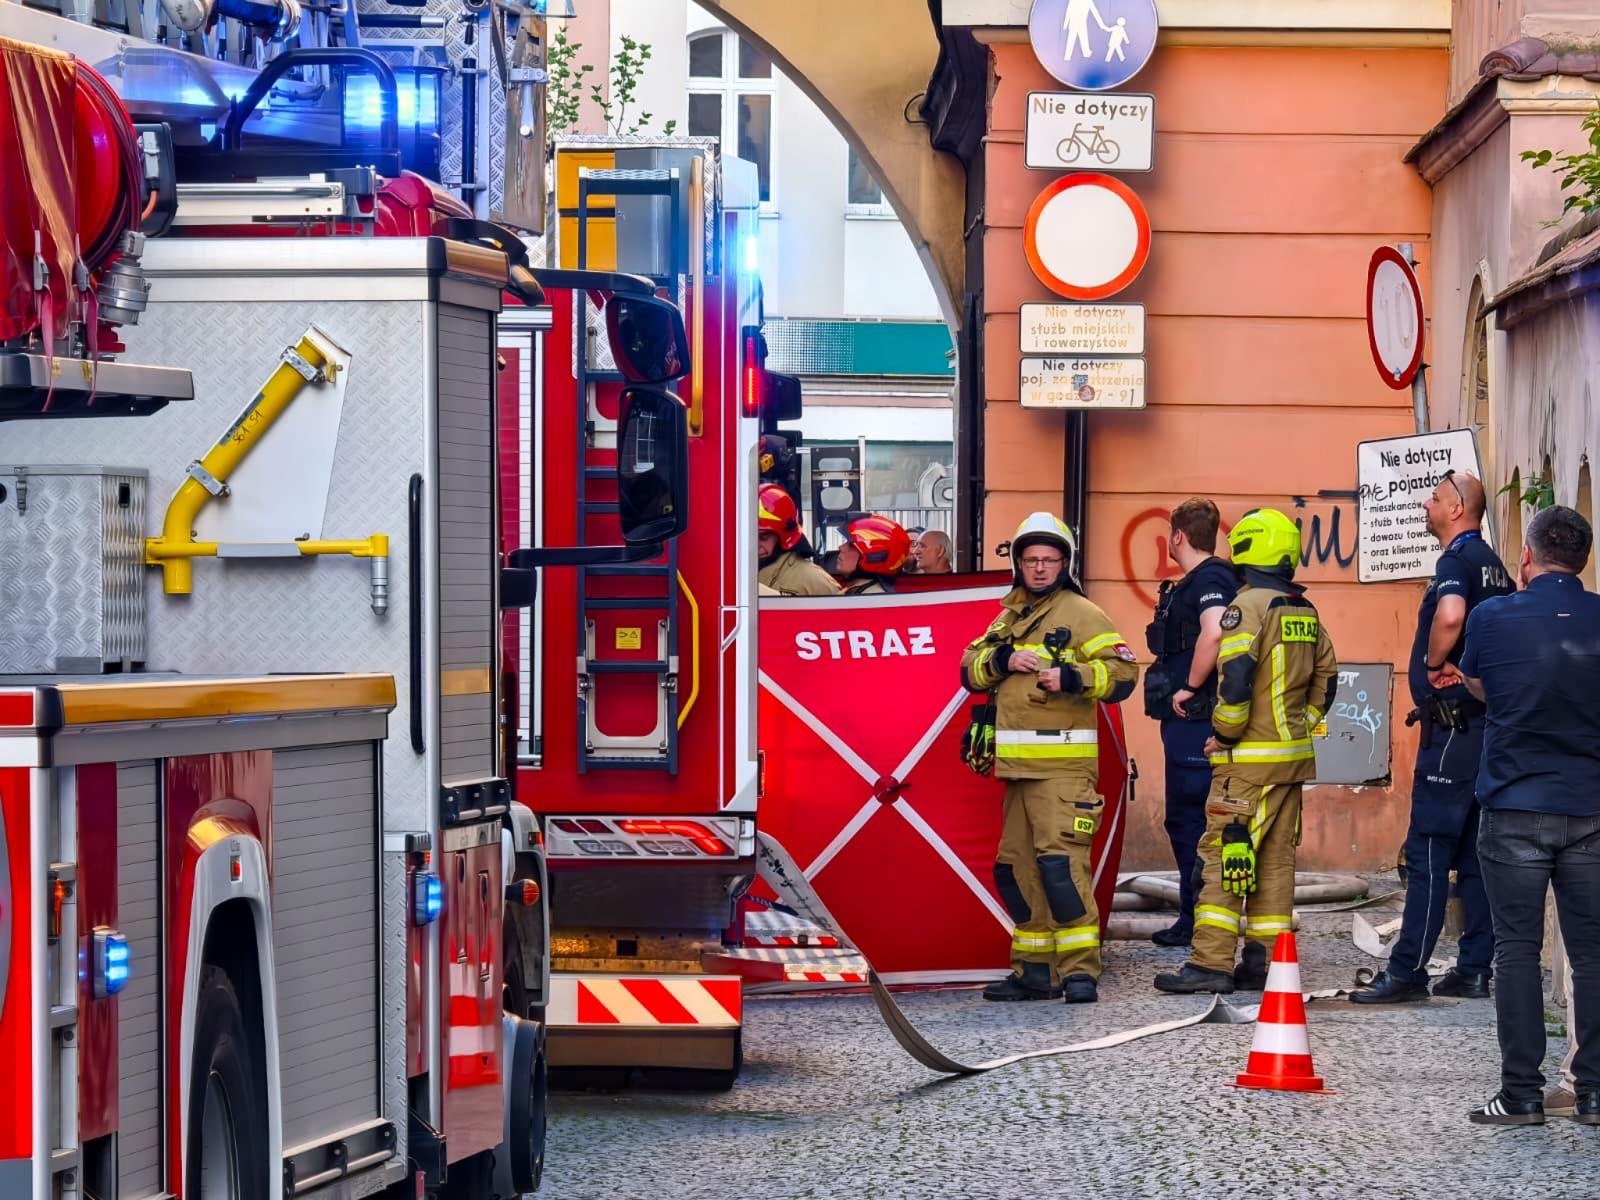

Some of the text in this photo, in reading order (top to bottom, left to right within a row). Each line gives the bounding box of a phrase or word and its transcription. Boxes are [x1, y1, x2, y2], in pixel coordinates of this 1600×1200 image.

[1033, 97, 1148, 122] Nie dotyczy
[1045, 306, 1126, 320] Nie dotyczy
[1072, 323, 1136, 337] miejskich
[1042, 360, 1123, 374] Nie dotyczy
[1380, 448, 1452, 468] Nie dotyczy
[1370, 517, 1392, 528] służb
[1370, 533, 1403, 542] dowozu
[1370, 549, 1389, 557] oraz
[1392, 545, 1428, 555] klientów
[1370, 558, 1422, 573] usługowych
